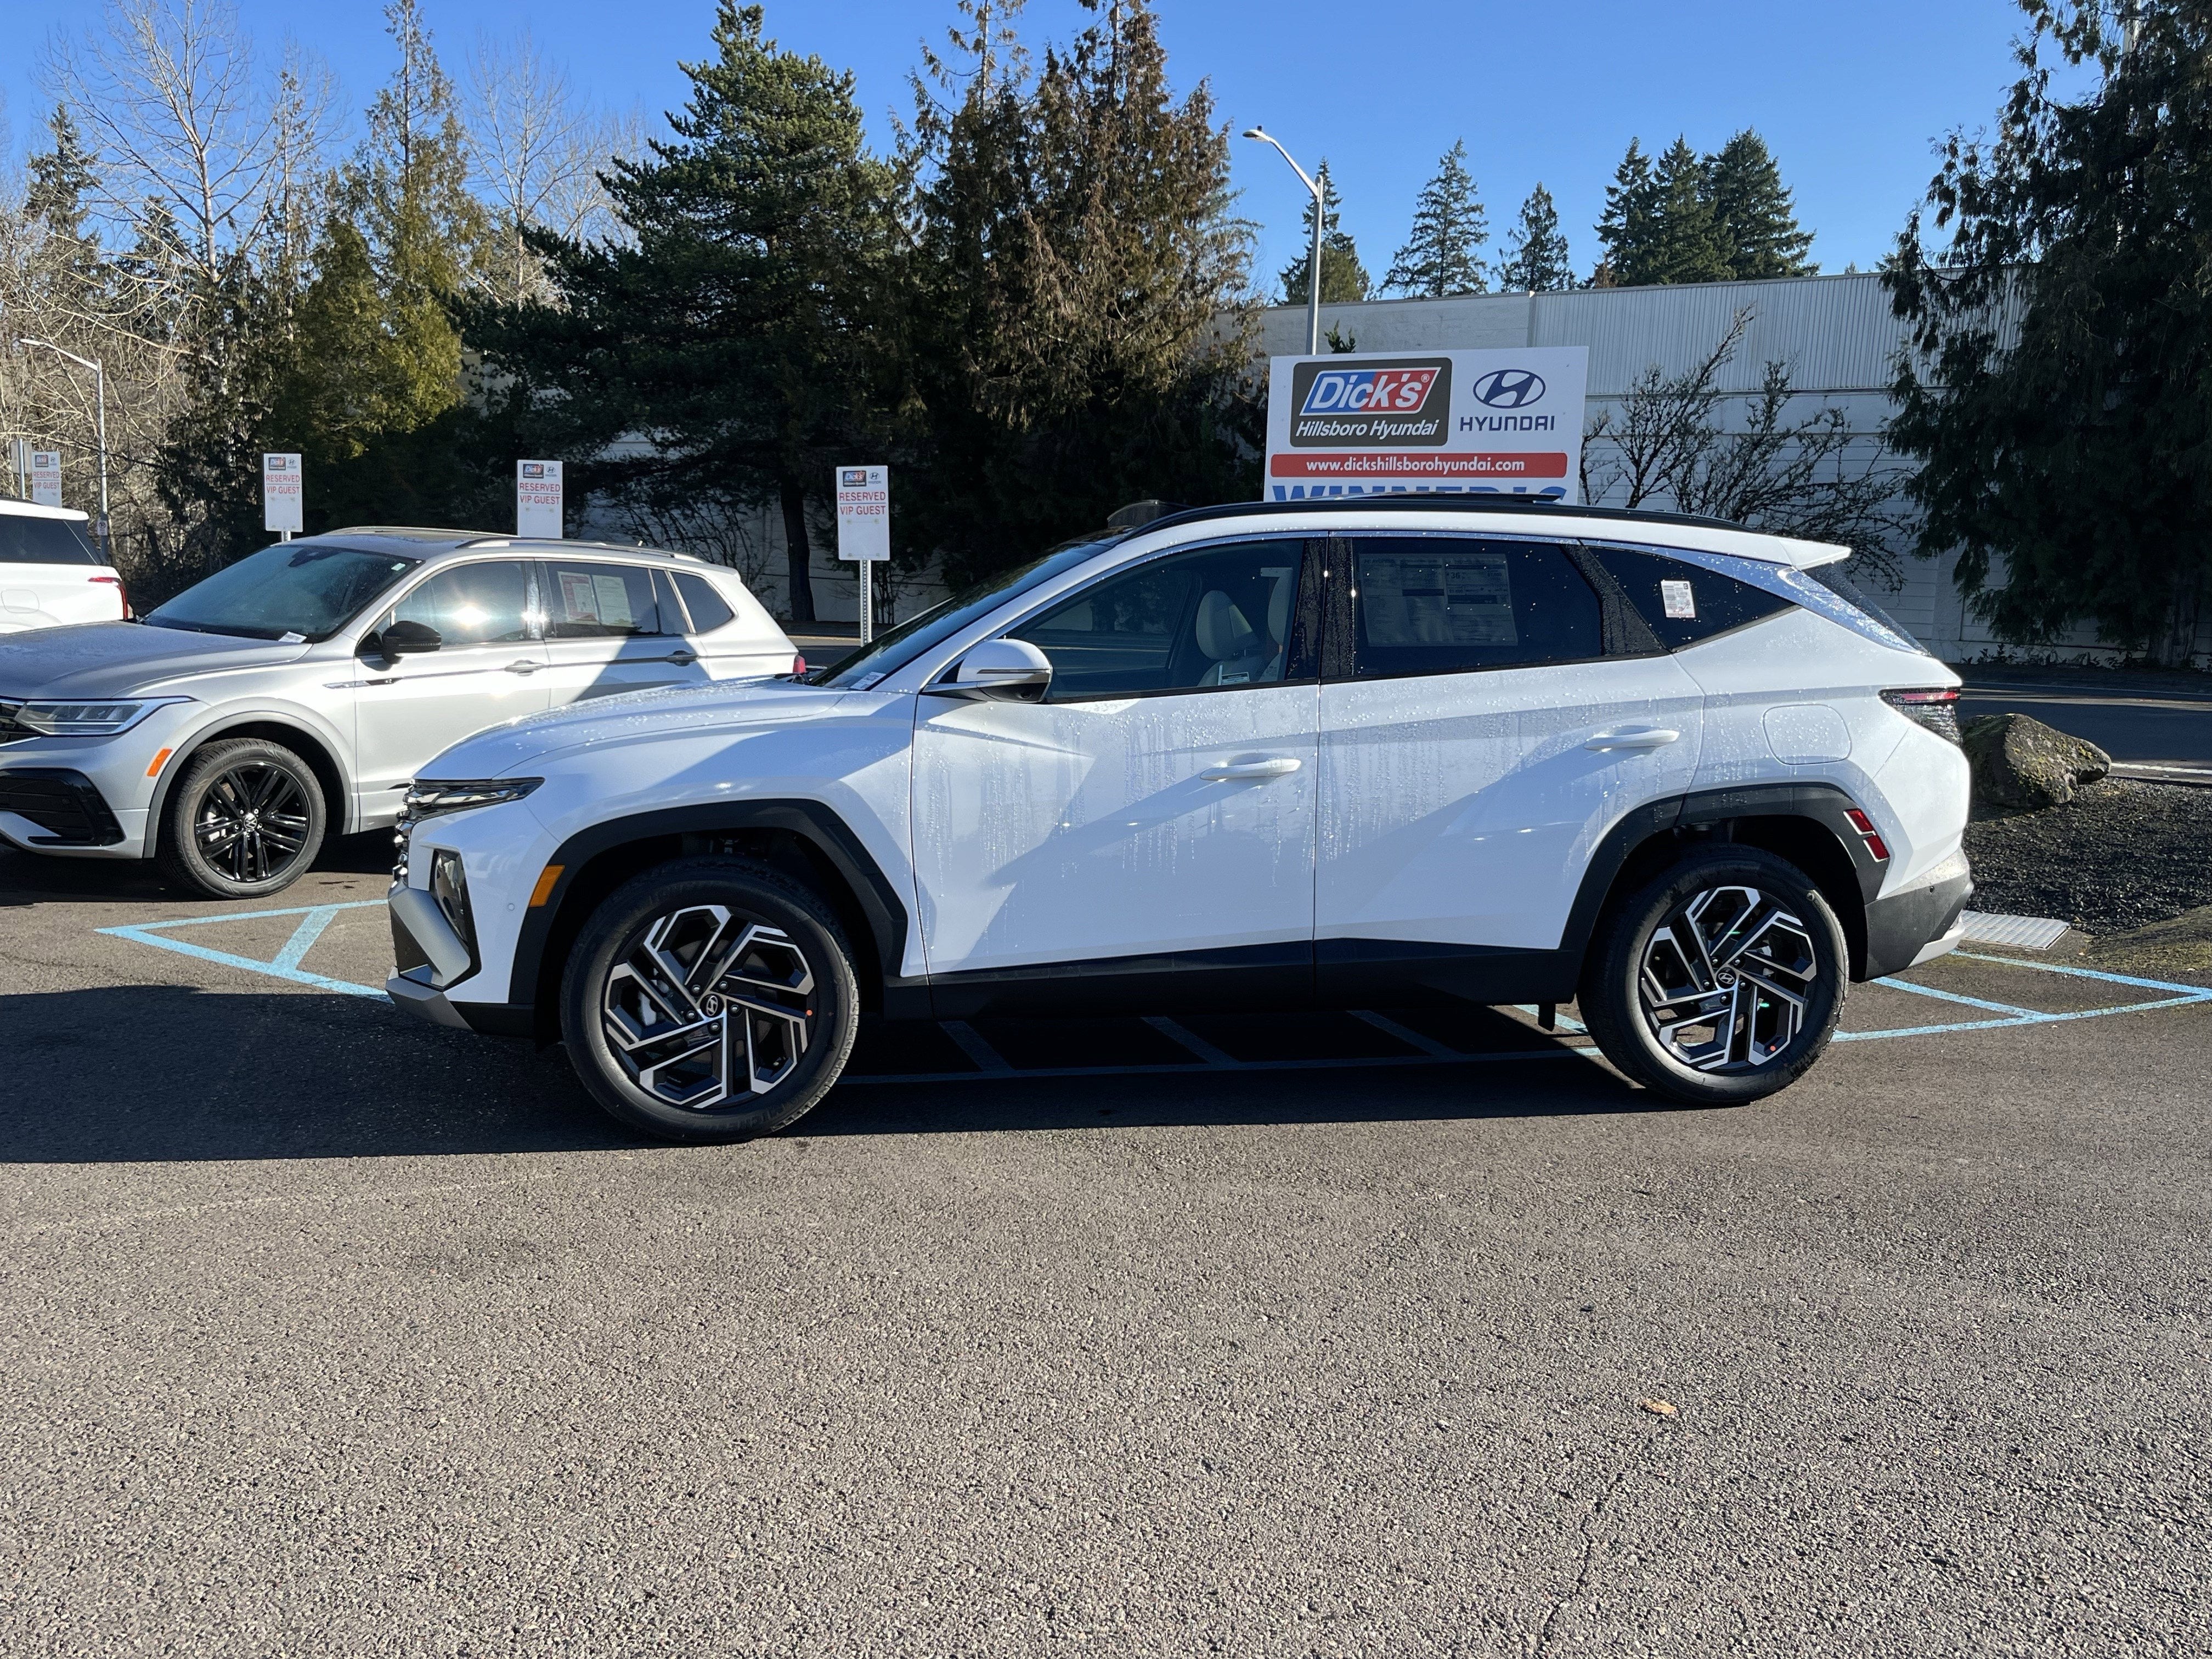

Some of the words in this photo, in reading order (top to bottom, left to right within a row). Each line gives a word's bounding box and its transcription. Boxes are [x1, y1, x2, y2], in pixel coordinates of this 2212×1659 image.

[1310, 374, 1424, 409] Dick's
[1295, 421, 1366, 437] Hillsboro
[1369, 419, 1440, 440] Hyundai
[1460, 415, 1555, 432] HYUNDAI
[1306, 456, 1525, 475] www.dickshillsborohyundai.com
[519, 483, 561, 492] RESERVED
[520, 495, 532, 503] VIP
[534, 495, 560, 505] GUEST
[839, 492, 886, 501] RESERVED
[840, 506, 854, 515] VIP
[856, 506, 886, 515] GUEST
